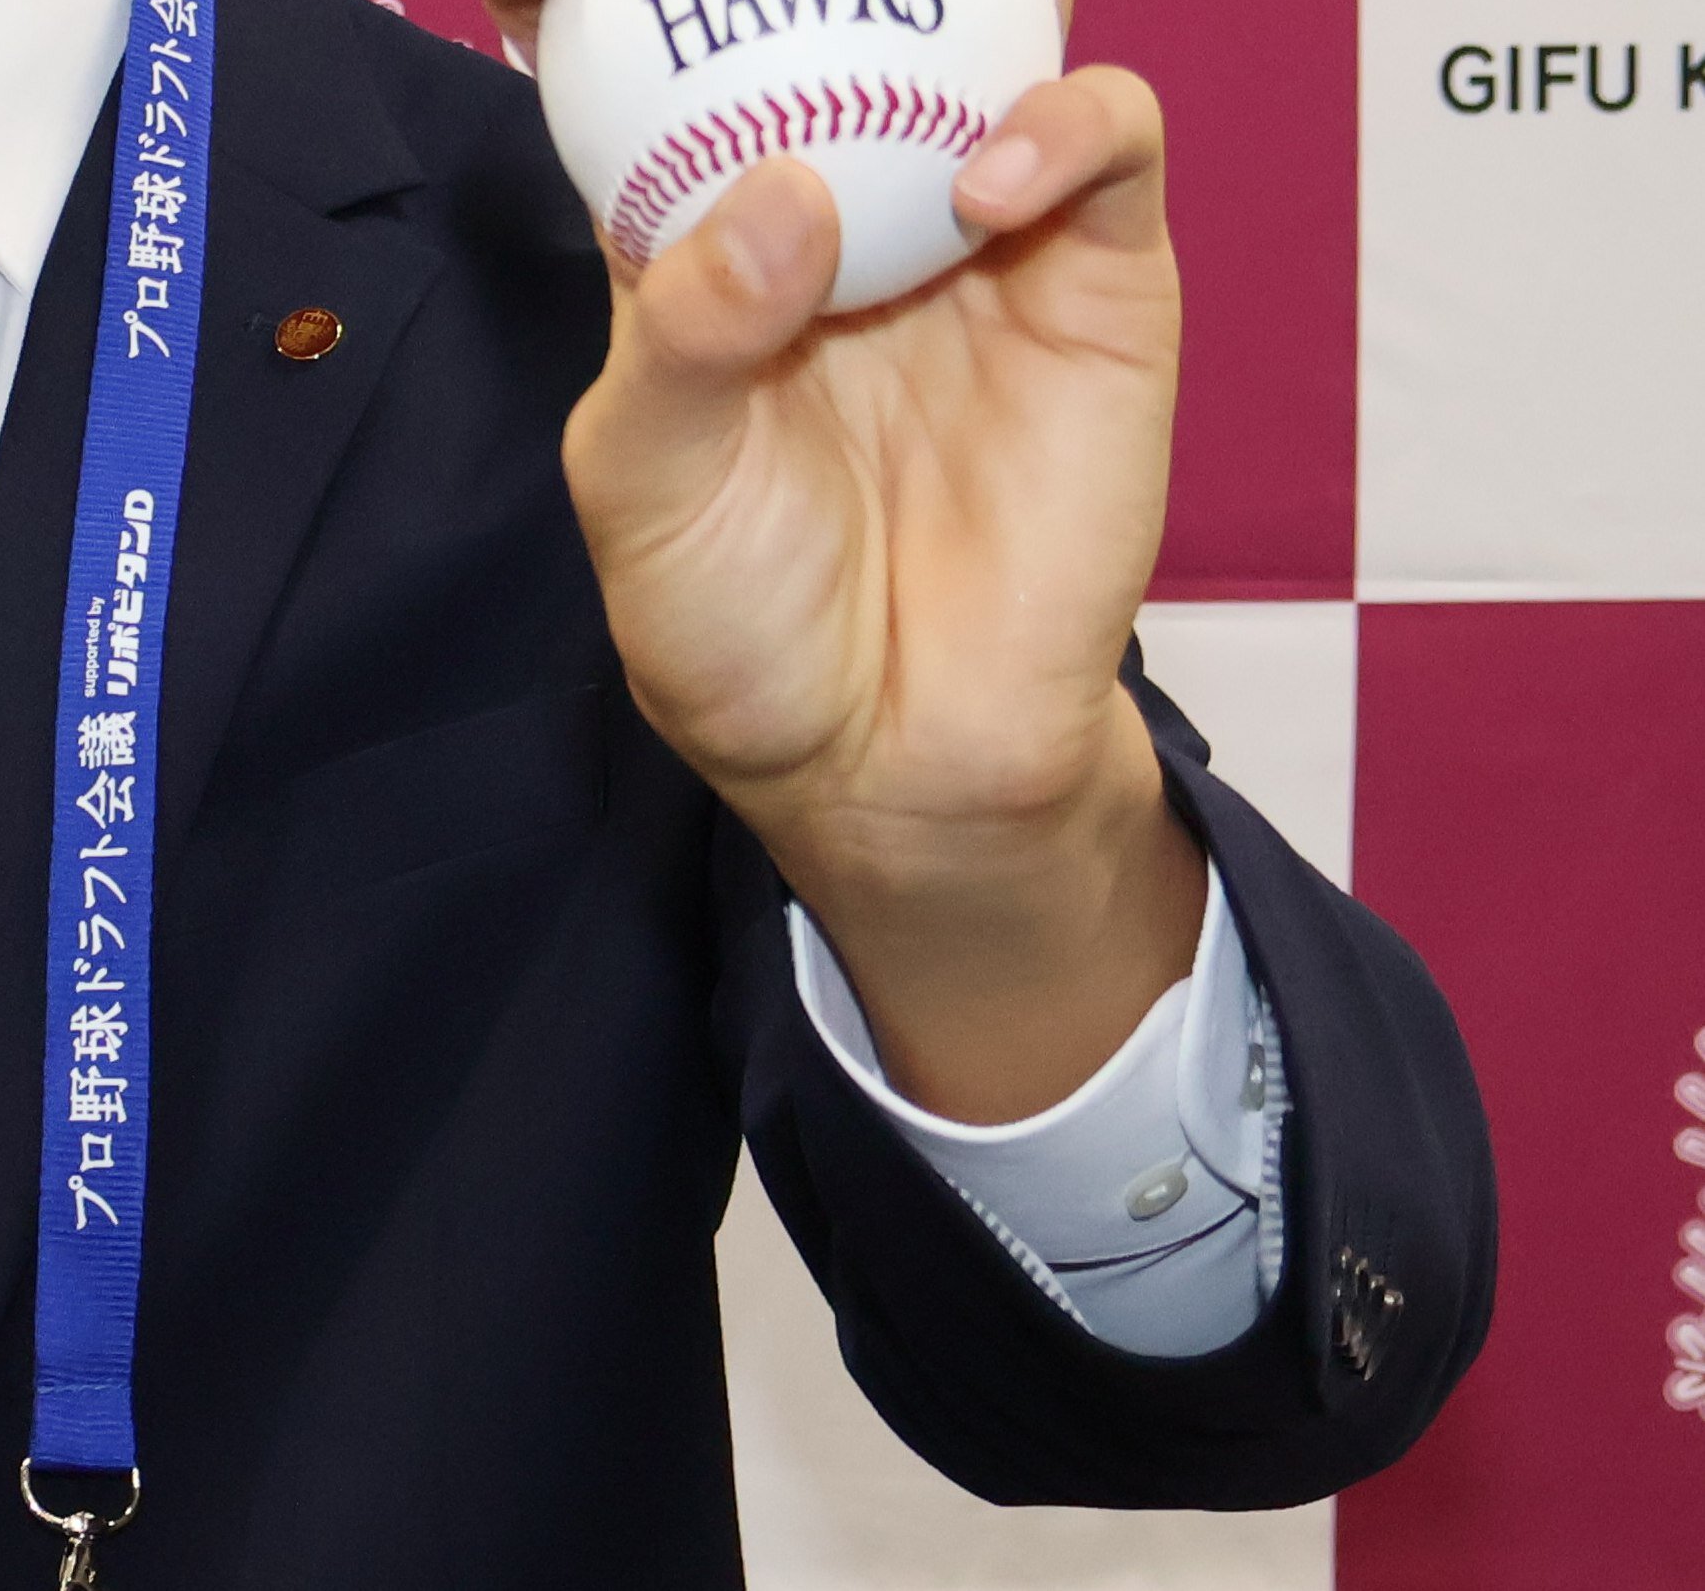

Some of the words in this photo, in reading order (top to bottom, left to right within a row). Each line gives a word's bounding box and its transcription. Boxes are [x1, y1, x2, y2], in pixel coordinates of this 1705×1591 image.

[1439, 43, 1638, 115] GIFU
[86, 596, 106, 615] by
[106, 488, 155, 696] リポビタンD
[83, 618, 102, 698] supported
[68, 710, 136, 1231] プロ野球ドラフト会議
